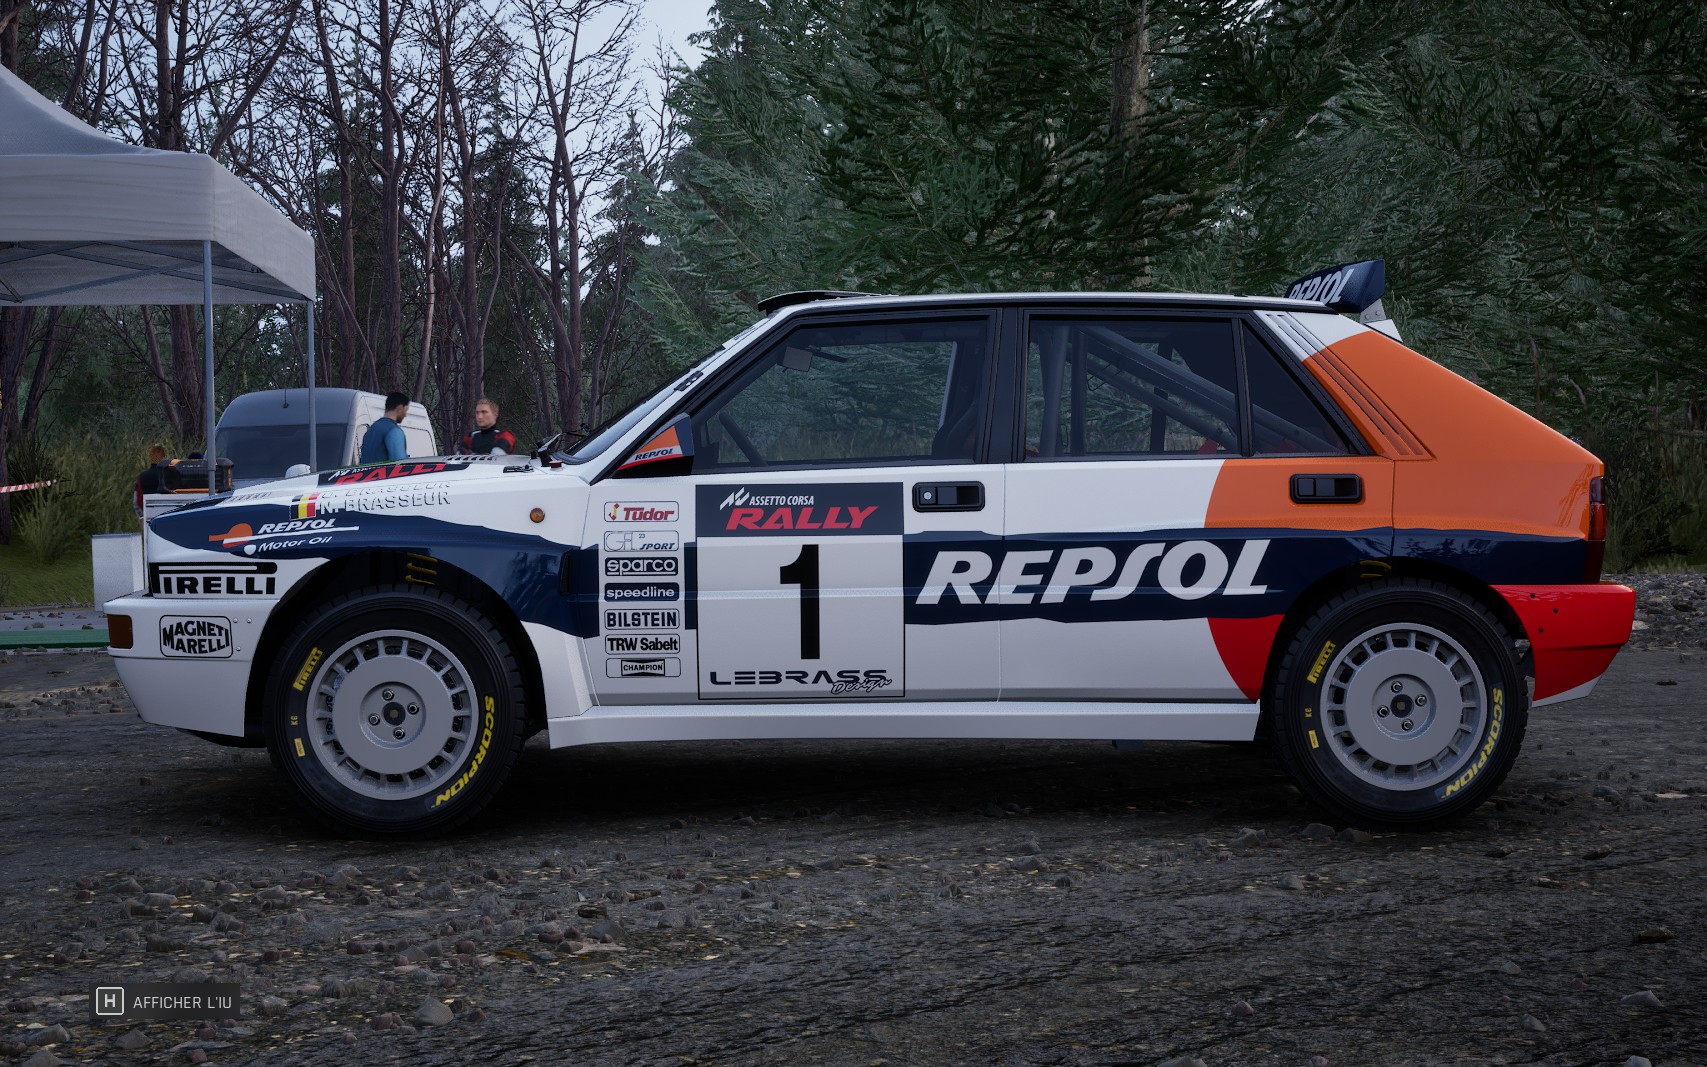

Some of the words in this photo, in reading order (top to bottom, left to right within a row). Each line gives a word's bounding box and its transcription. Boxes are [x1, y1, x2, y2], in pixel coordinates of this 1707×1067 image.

[1289, 268, 1354, 304] REPSOL
[634, 447, 674, 461] REPSOL
[344, 491, 451, 512] BRASSEUR
[749, 495, 785, 506] ASSETTO
[786, 495, 814, 506] CORSA
[257, 518, 337, 535] REPSOL
[725, 506, 879, 531] RALLY
[257, 537, 306, 553] Motor
[308, 534, 333, 547] Oil
[639, 542, 676, 550] SPORT
[606, 558, 676, 575] sparco
[915, 539, 1271, 605] REPSOL
[149, 562, 278, 595] PIRELLI
[606, 586, 675, 599] speedline
[779, 544, 821, 660] 1
[606, 611, 677, 628] BILSTEIN
[162, 620, 230, 641] MAGNETI
[607, 638, 638, 651] TRW
[640, 637, 678, 651] Sabelt
[292, 647, 324, 691] PIRELLI
[623, 664, 663, 673] CHAMPION
[1306, 640, 1337, 684] PIRELLI
[709, 670, 887, 686] LEBRASS
[831, 676, 892, 695] Design
[290, 715, 299, 726] K6
[434, 695, 495, 807] SCORPION
[1445, 687, 1503, 797] SCORPION
